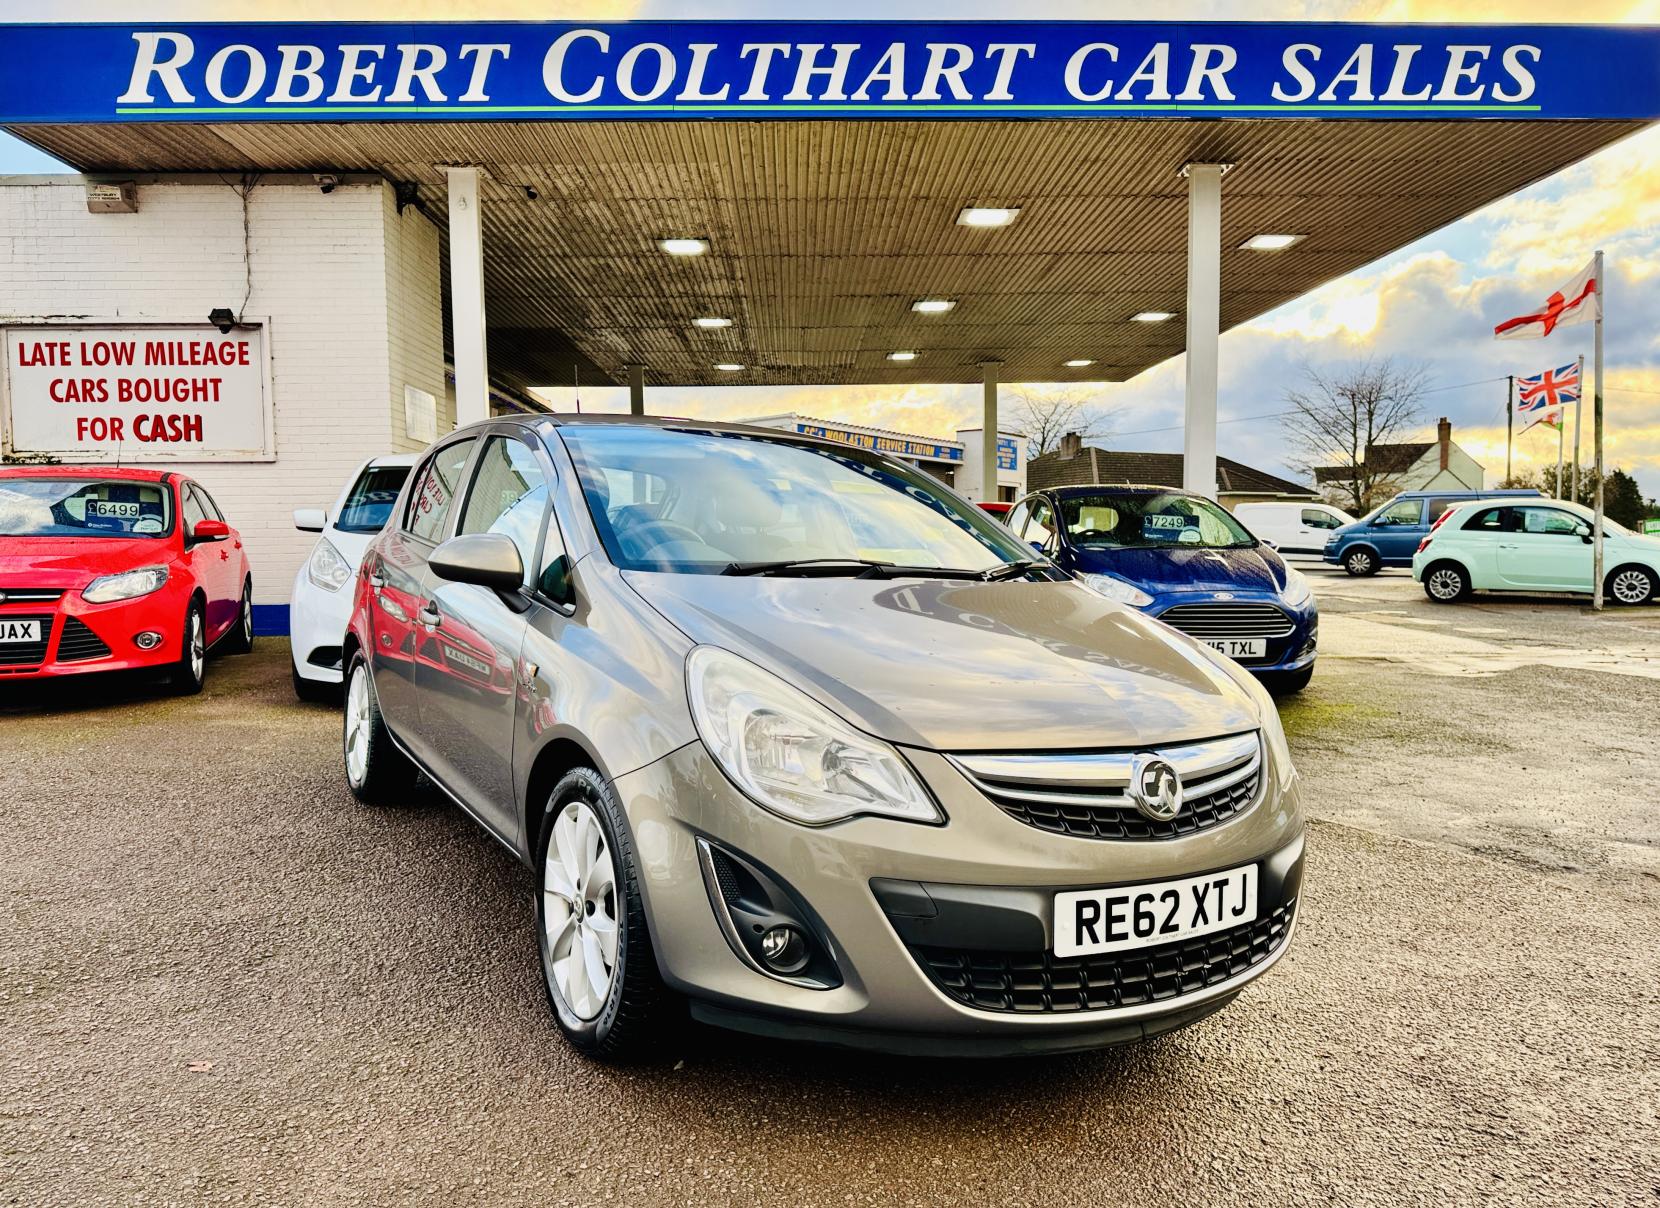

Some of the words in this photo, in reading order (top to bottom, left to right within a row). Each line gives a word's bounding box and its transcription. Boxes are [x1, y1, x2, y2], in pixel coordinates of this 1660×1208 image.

[117, 32, 511, 104] ROBERT
[542, 28, 1037, 104] COLTHART
[1064, 42, 1238, 102] CAR
[1271, 43, 1542, 103] SALES
[18, 341, 72, 367] LATE
[80, 341, 136, 366] LOW
[144, 341, 250, 366] MILEAGE
[49, 378, 109, 403] CARS
[117, 378, 222, 402] BOUGHT
[76, 417, 125, 441] FOR
[132, 414, 203, 442] CASH
[825, 429, 874, 449] WOOLASTON
[877, 437, 906, 453] SERVICE
[908, 441, 935, 457] STATION
[0, 623, 32, 640] JAX
[1229, 641, 1257, 655] TXL
[1075, 888, 1181, 947] RE62
[1191, 873, 1248, 929] XTJ
